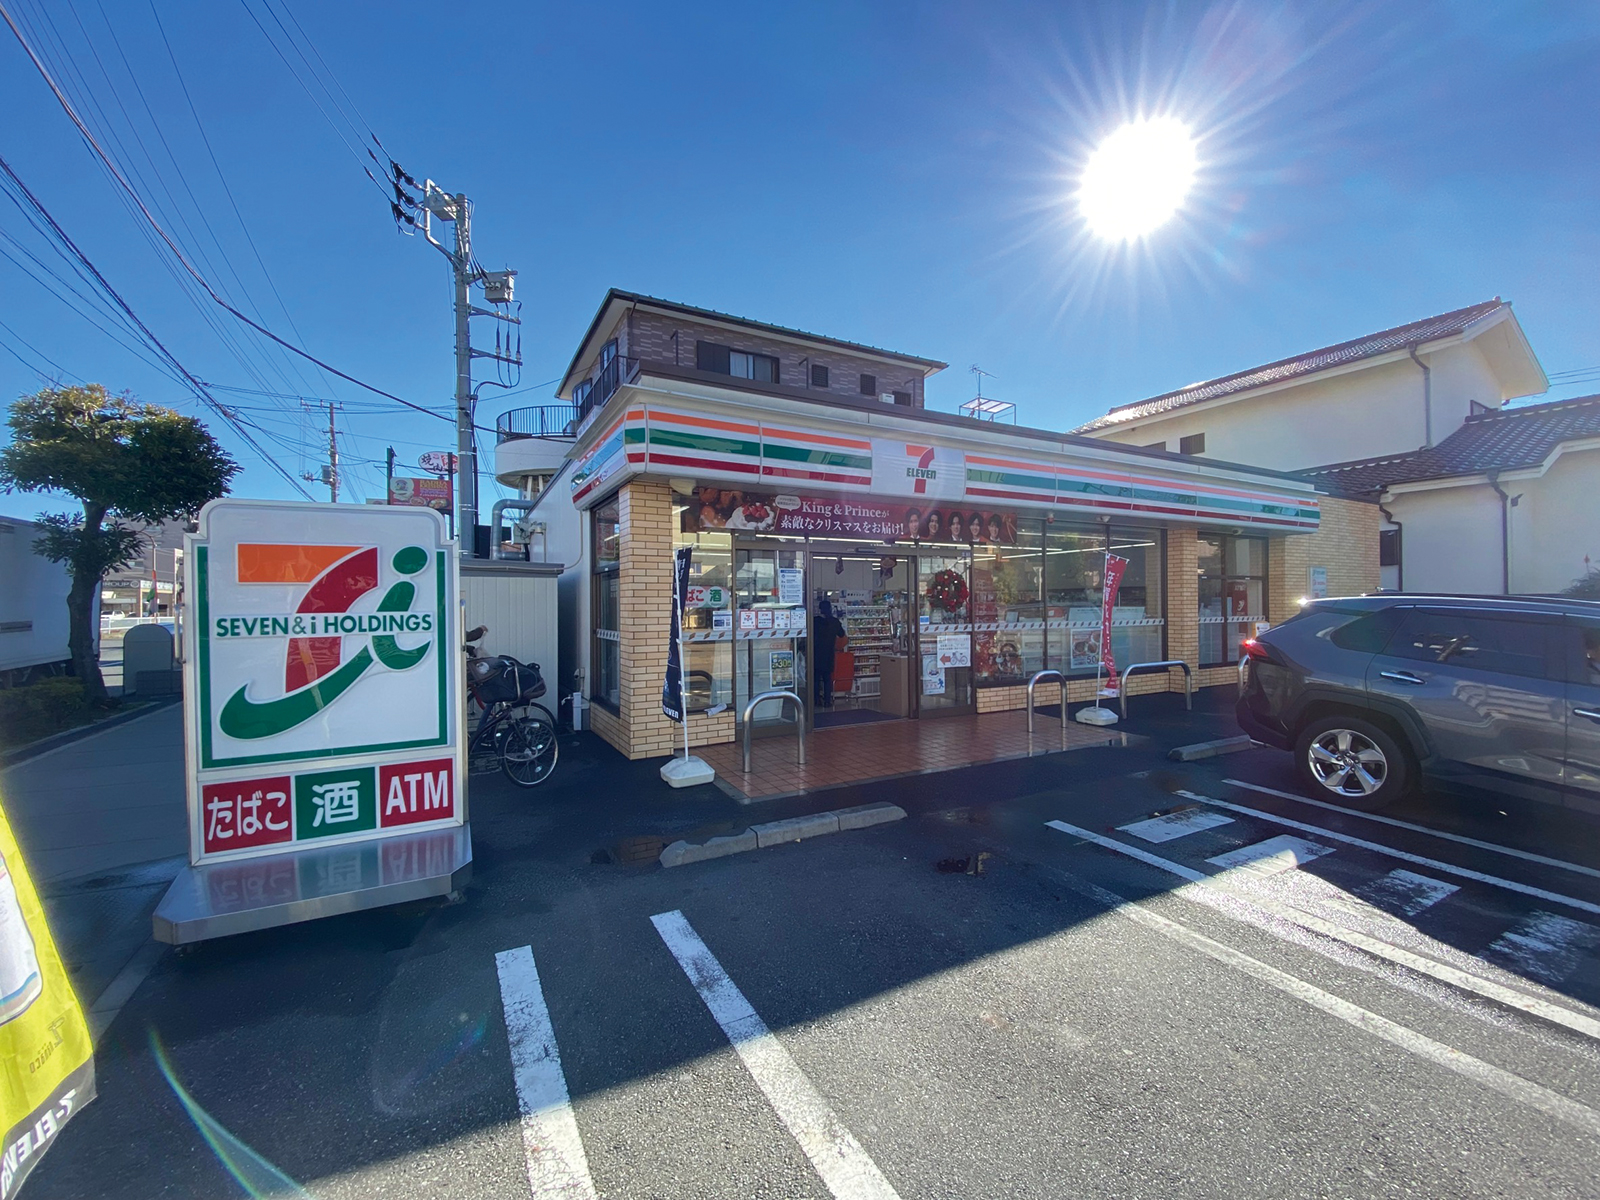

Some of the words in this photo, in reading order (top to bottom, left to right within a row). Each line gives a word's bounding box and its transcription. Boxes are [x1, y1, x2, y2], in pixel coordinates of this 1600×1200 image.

[802, 501, 833, 516] King
[833, 504, 843, 514] &
[686, 588, 704, 602] ばこ
[710, 589, 722, 602] 酒
[324, 613, 432, 634] HOLDINGS
[311, 779, 361, 828] 酒
[385, 769, 448, 816] ATM
[206, 790, 289, 841] たばこ
